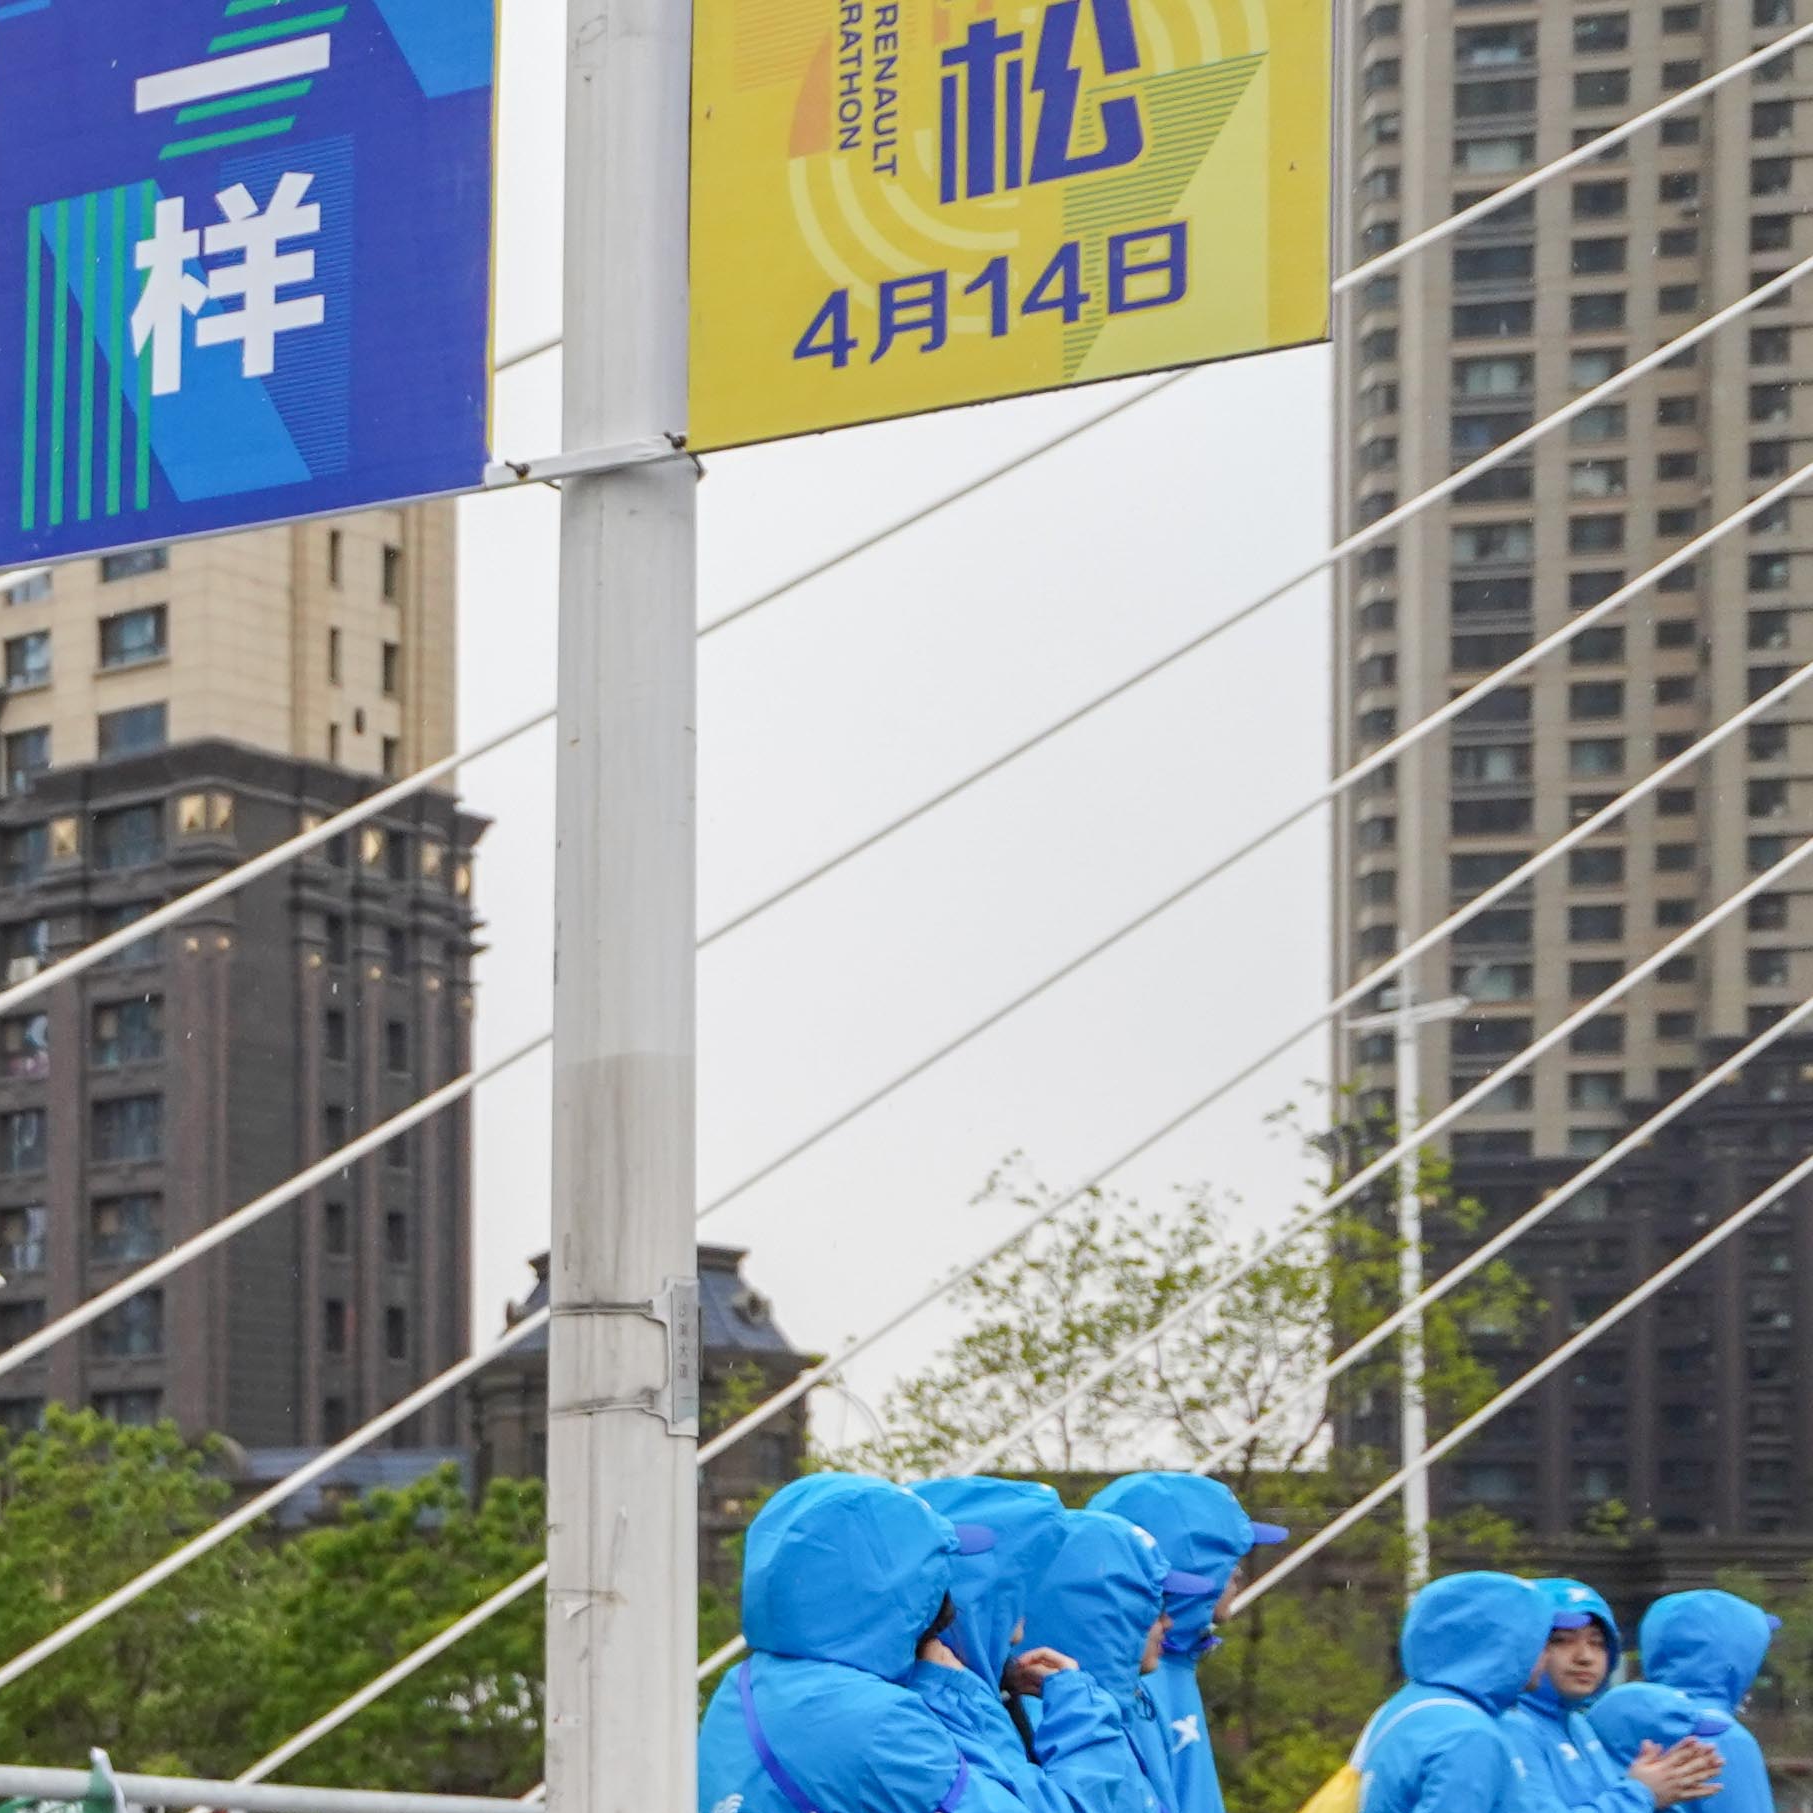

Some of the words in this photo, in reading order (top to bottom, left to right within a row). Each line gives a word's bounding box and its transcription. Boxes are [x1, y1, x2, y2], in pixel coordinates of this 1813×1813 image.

[838, 0, 863, 151] RATHON
[873, 2, 899, 177] RENAULT
[939, 0, 1145, 205] 松
[792, 219, 1189, 370] 4月14日
